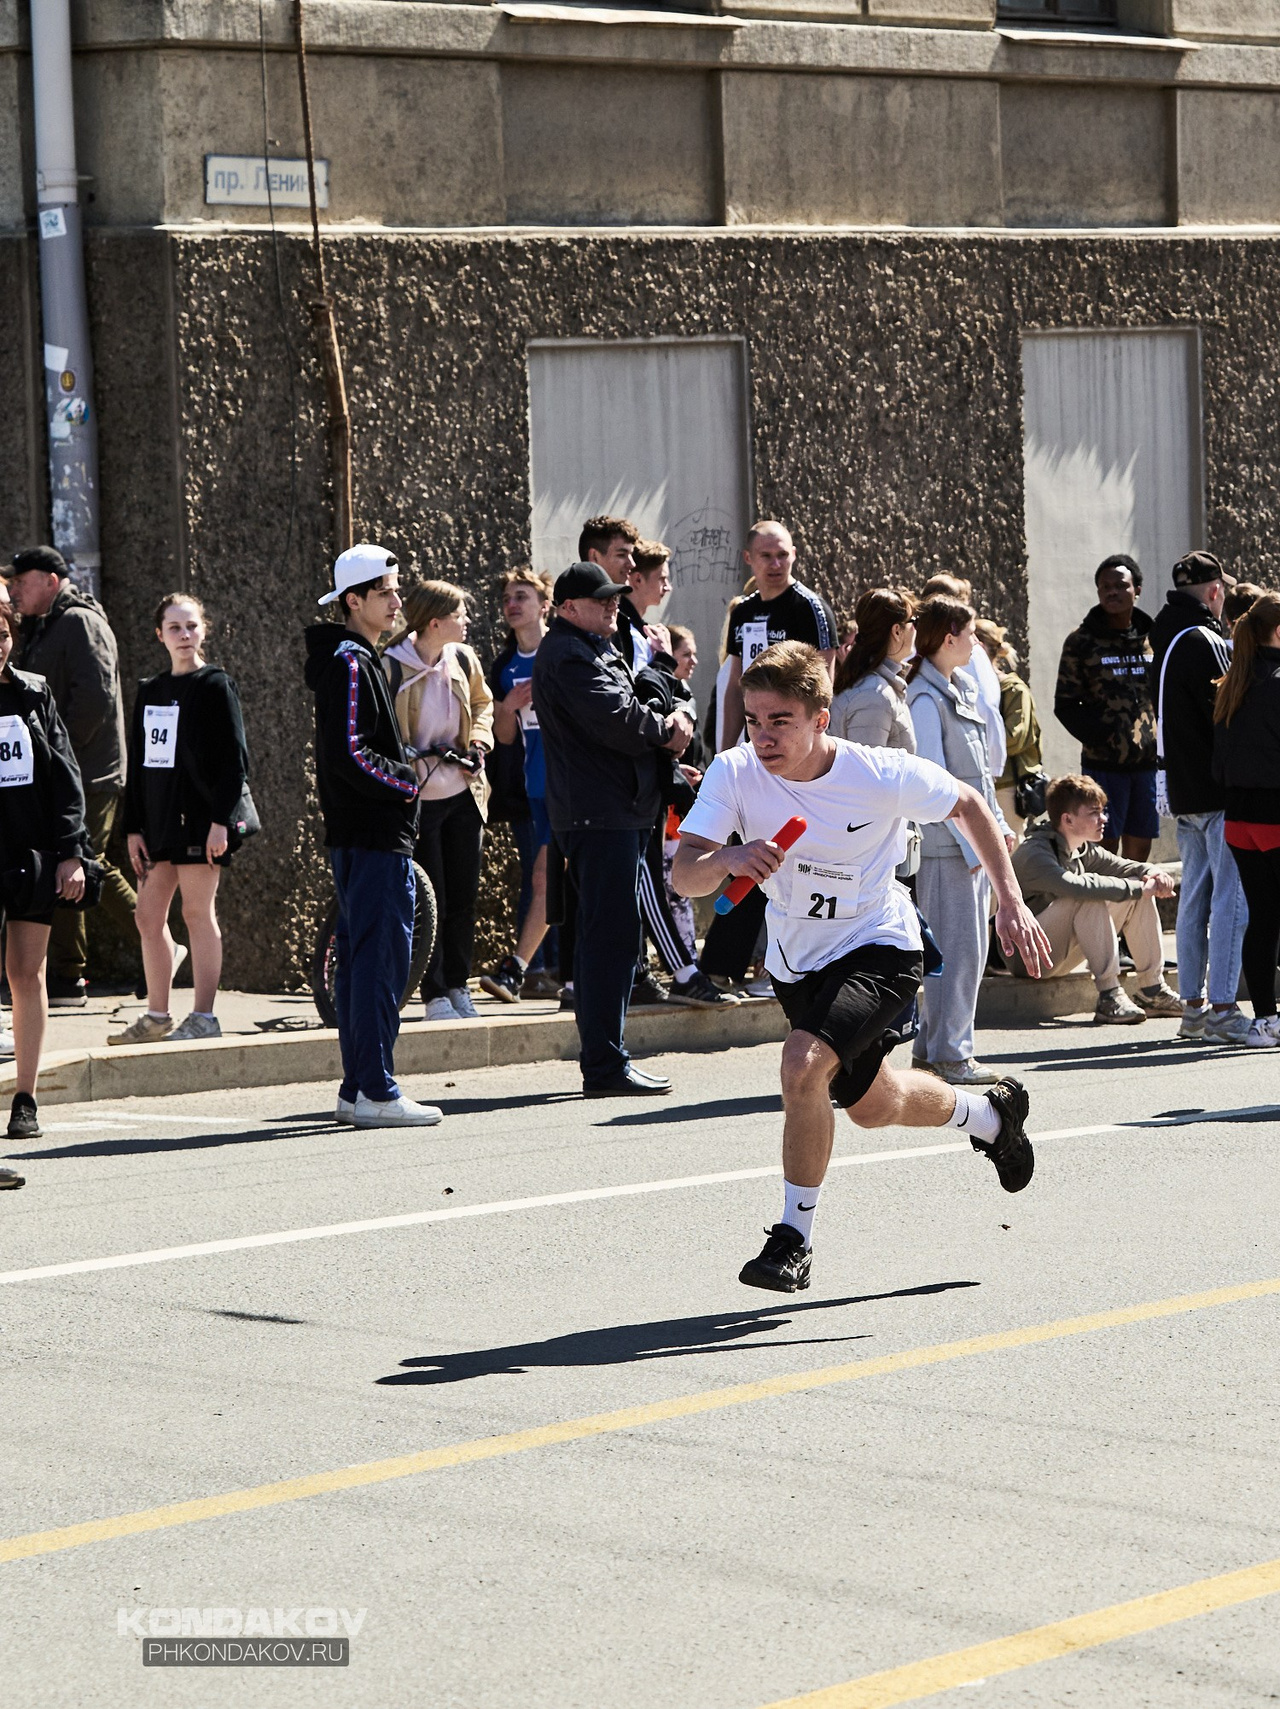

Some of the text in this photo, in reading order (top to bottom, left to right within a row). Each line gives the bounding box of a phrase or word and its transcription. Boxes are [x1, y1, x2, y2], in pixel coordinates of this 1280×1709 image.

[214, 170, 244, 195] пр.
[750, 643, 764, 659] 86
[151, 728, 168, 745] 94
[0, 741, 23, 761] 84
[808, 893, 837, 919] 21
